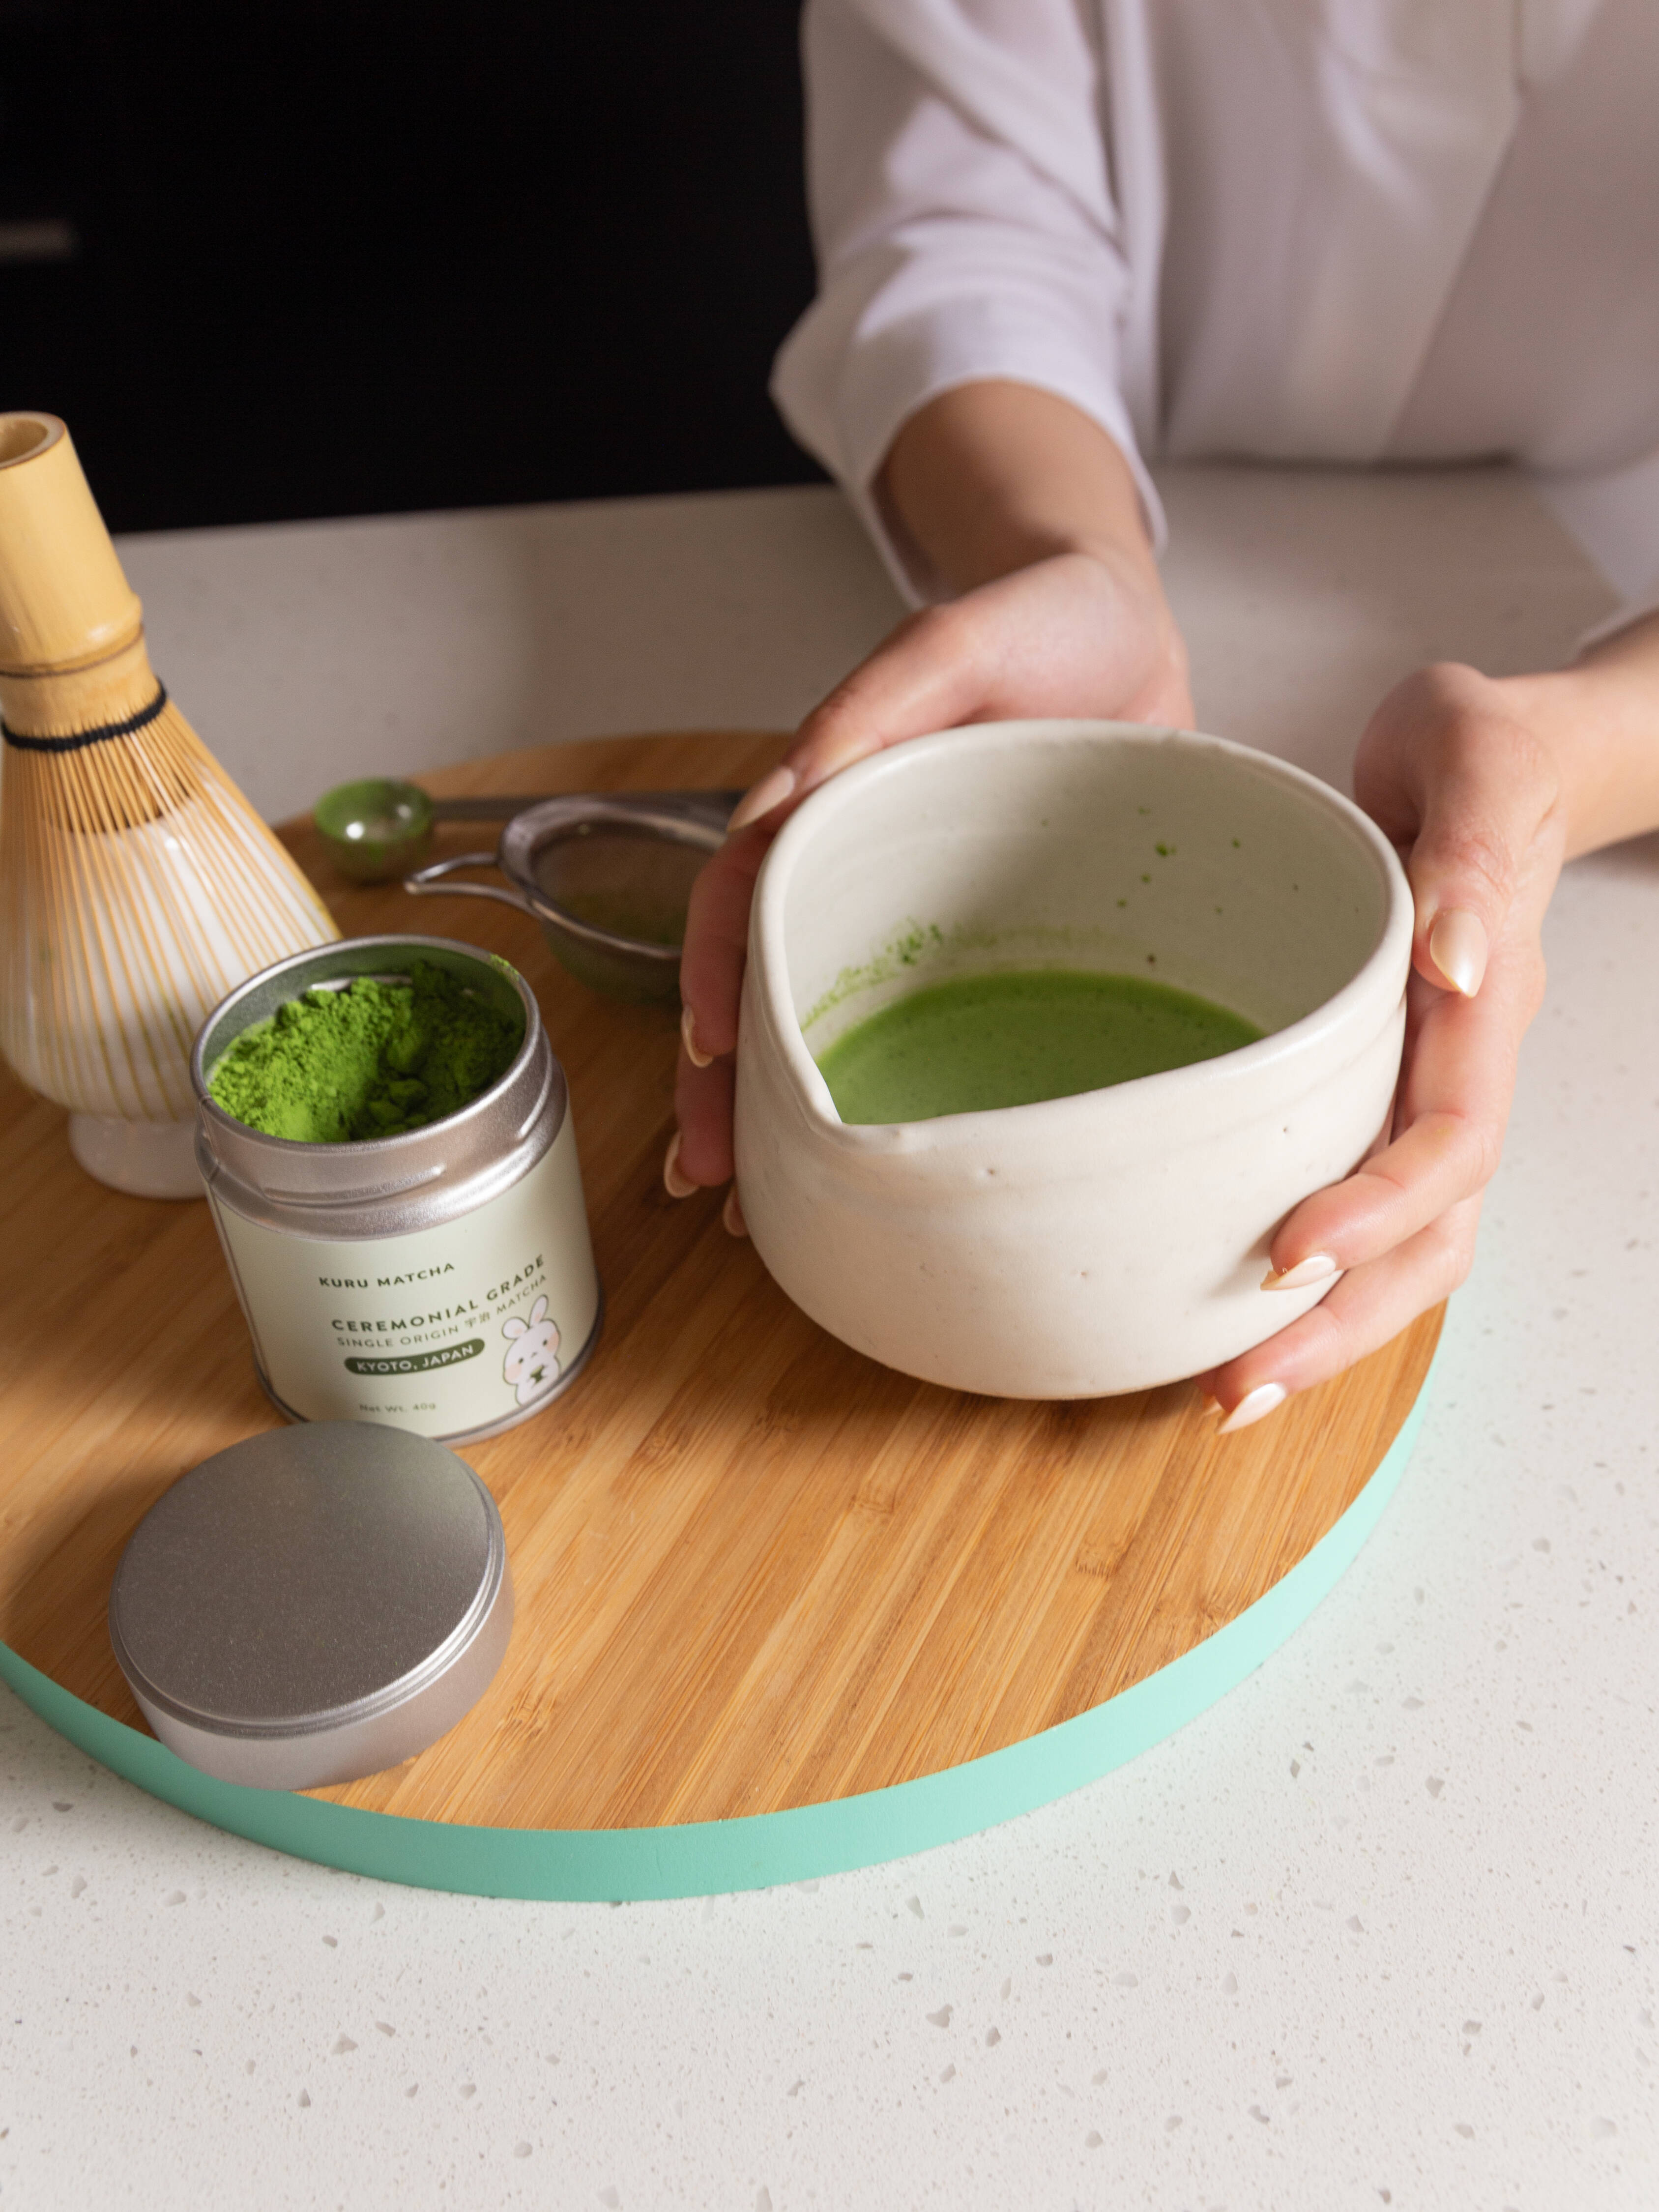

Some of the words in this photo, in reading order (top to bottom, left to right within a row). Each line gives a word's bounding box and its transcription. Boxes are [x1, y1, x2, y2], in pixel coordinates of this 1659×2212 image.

[319, 1277, 368, 1288] KURU
[378, 1262, 455, 1287] MATCHA
[332, 1299, 479, 1332] CEREMONIAL
[486, 1254, 544, 1301] GRADE
[337, 1336, 393, 1348] SINGLE
[400, 1325, 459, 1345] ORIGIN
[496, 1275, 547, 1314] MATCHA
[356, 1360, 418, 1372] KYOTO,
[422, 1344, 474, 1368] JAPAN
[359, 1403, 380, 1412] Net
[413, 1401, 436, 1412] 40g
